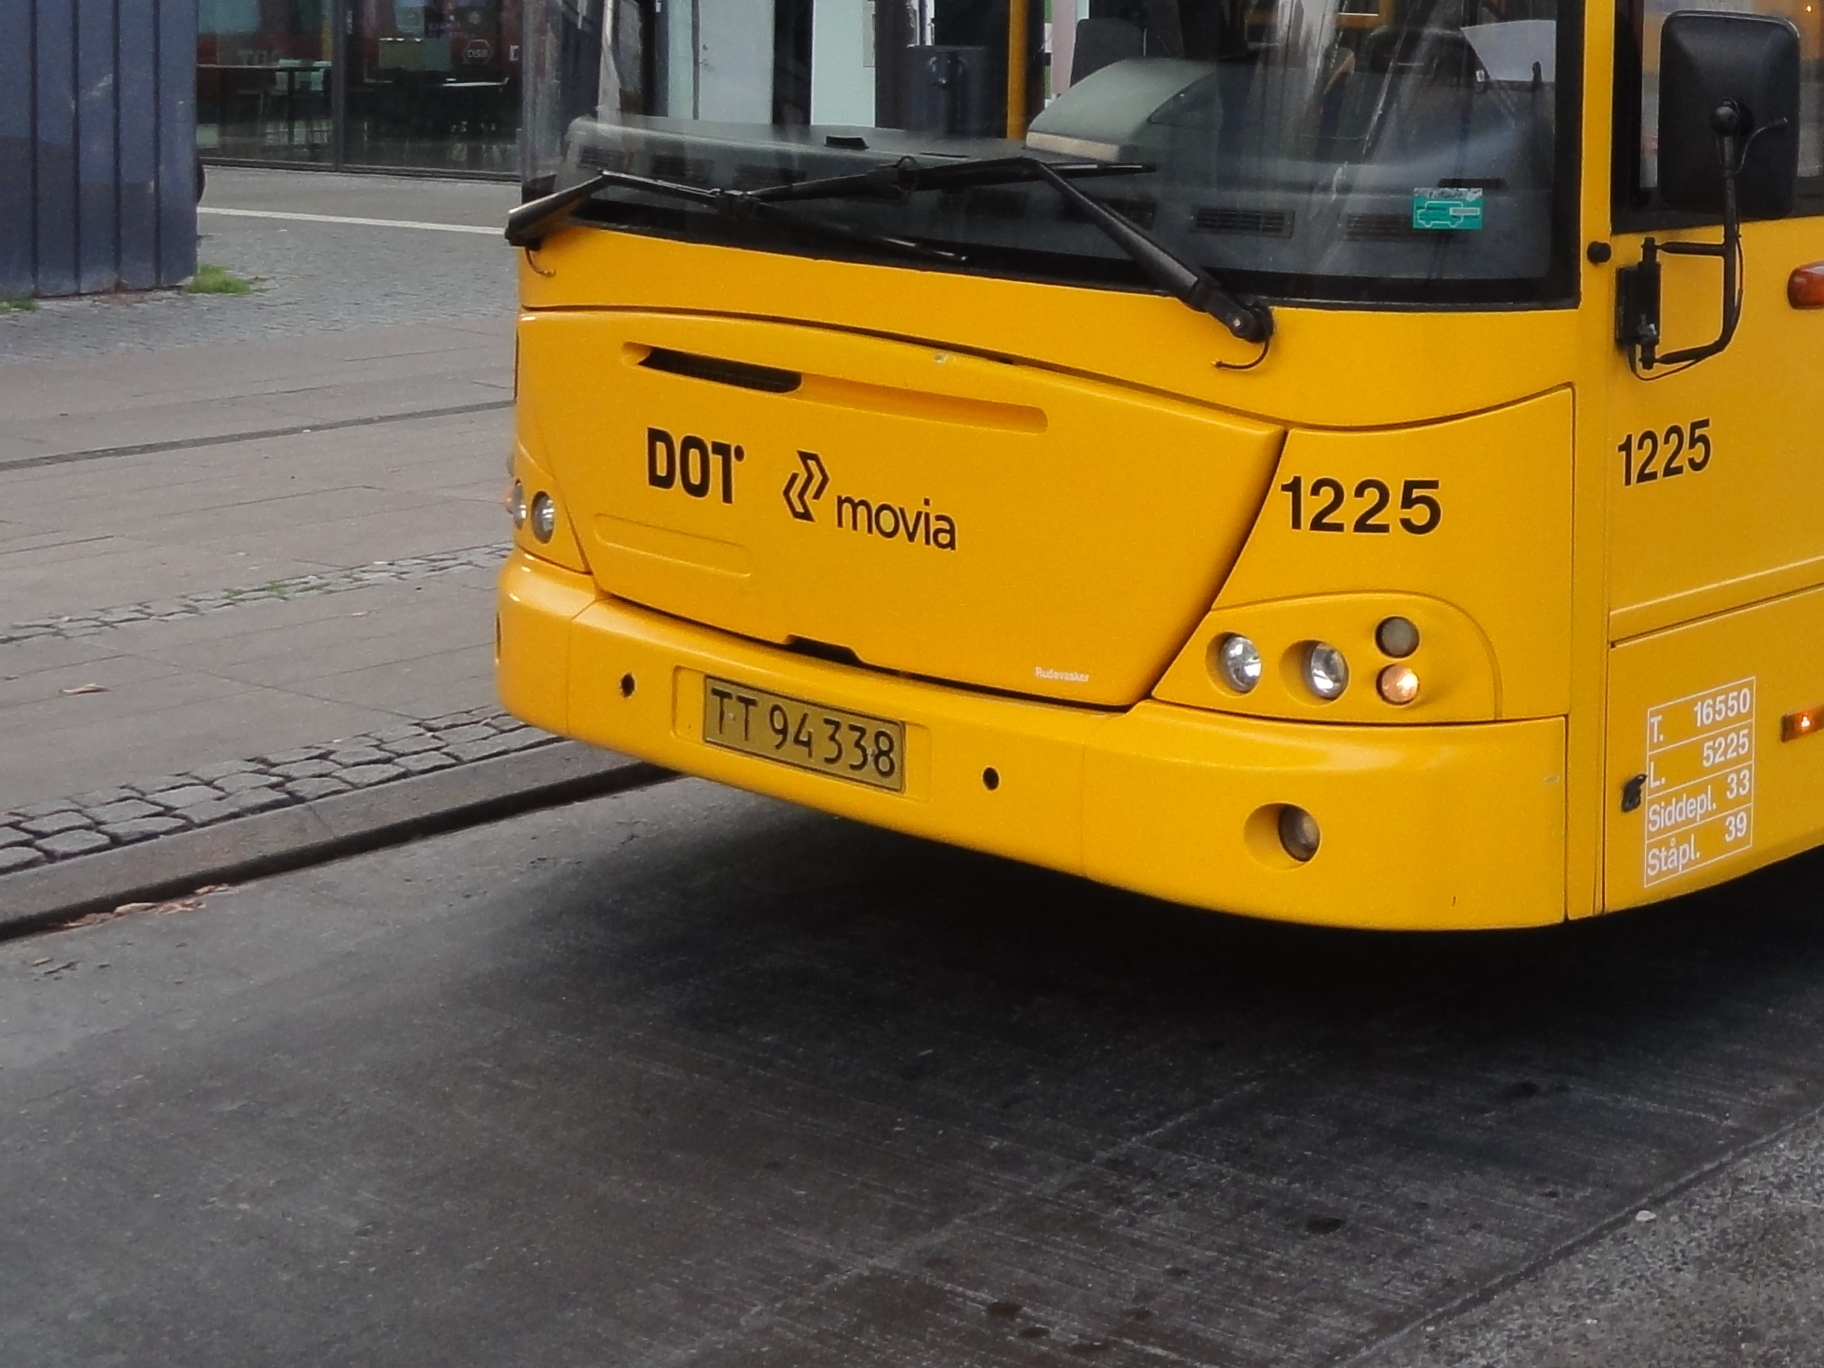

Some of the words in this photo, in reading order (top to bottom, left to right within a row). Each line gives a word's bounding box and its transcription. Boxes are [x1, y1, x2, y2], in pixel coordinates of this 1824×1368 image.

[647, 427, 744, 505] DOT
[1616, 418, 1711, 486] 1225
[836, 495, 957, 551] movia
[1280, 475, 1441, 535] 1225
[711, 687, 758, 742] TT
[1650, 715, 1664, 743] T.
[1694, 688, 1750, 727] 16550
[1650, 761, 1665, 788] L.
[1703, 728, 1749, 767] 5225
[1649, 784, 1716, 832] Siddepl.
[1726, 769, 1749, 800] 33
[1647, 834, 1700, 876] Ståpl.
[1725, 812, 1747, 842] 39
